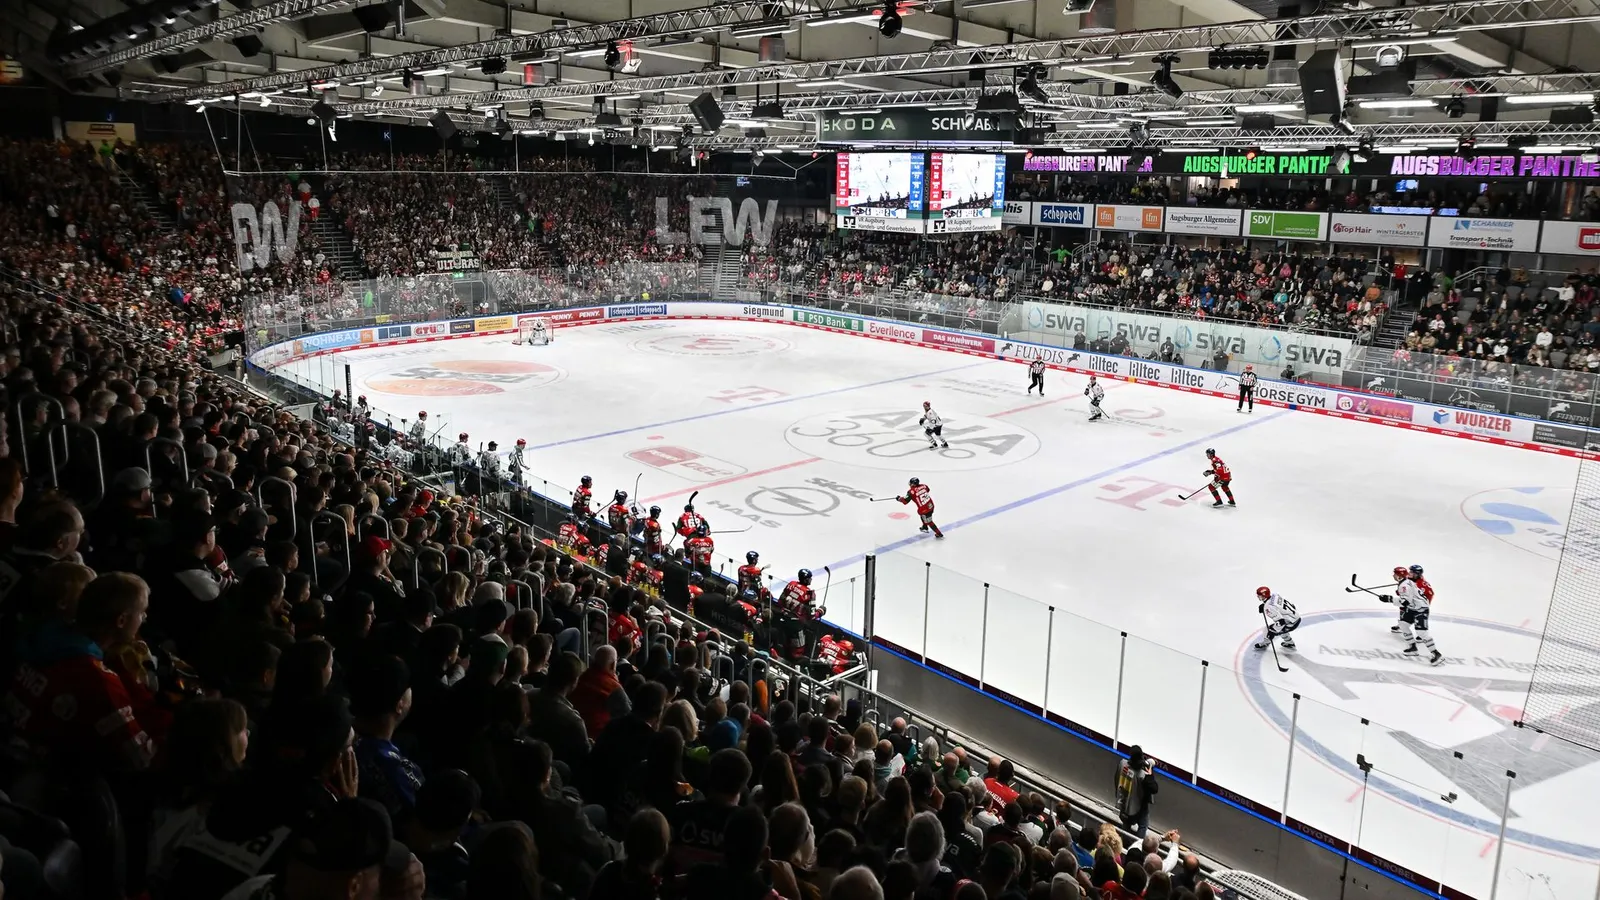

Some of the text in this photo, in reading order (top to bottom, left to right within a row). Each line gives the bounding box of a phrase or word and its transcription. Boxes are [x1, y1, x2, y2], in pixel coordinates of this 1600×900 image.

[1390, 156, 1514, 176] AUGSBURGER
[655, 197, 778, 246] LEW
[1043, 206, 1082, 223] scheppach
[1170, 214, 1236, 224] Augsburger Allgemeine
[1252, 215, 1270, 224] SDV
[744, 306, 784, 318] siegmund
[808, 313, 846, 328] PSD Bank
[415, 325, 436, 335] GTÜ
[870, 322, 916, 340] Everllence
[1046, 314, 1085, 332] swa
[1117, 322, 1160, 342] swa
[303, 332, 360, 347] WOHNBAU
[948, 336, 983, 348] HANDWERK
[1196, 333, 1246, 354] swa
[1014, 344, 1064, 364] FUNDIS
[1286, 344, 1342, 368] swa
[1252, 386, 1326, 408] HORSE GYM
[1455, 412, 1512, 432] WURZER
[706, 500, 782, 528] HAAS
[1000, 692, 1024, 708] TOYOTA
[1064, 720, 1094, 738] STROBEL
[1219, 788, 1256, 810] STROBEL
[1296, 822, 1336, 846] TOYOTA
[1372, 856, 1416, 882] STROBEL
